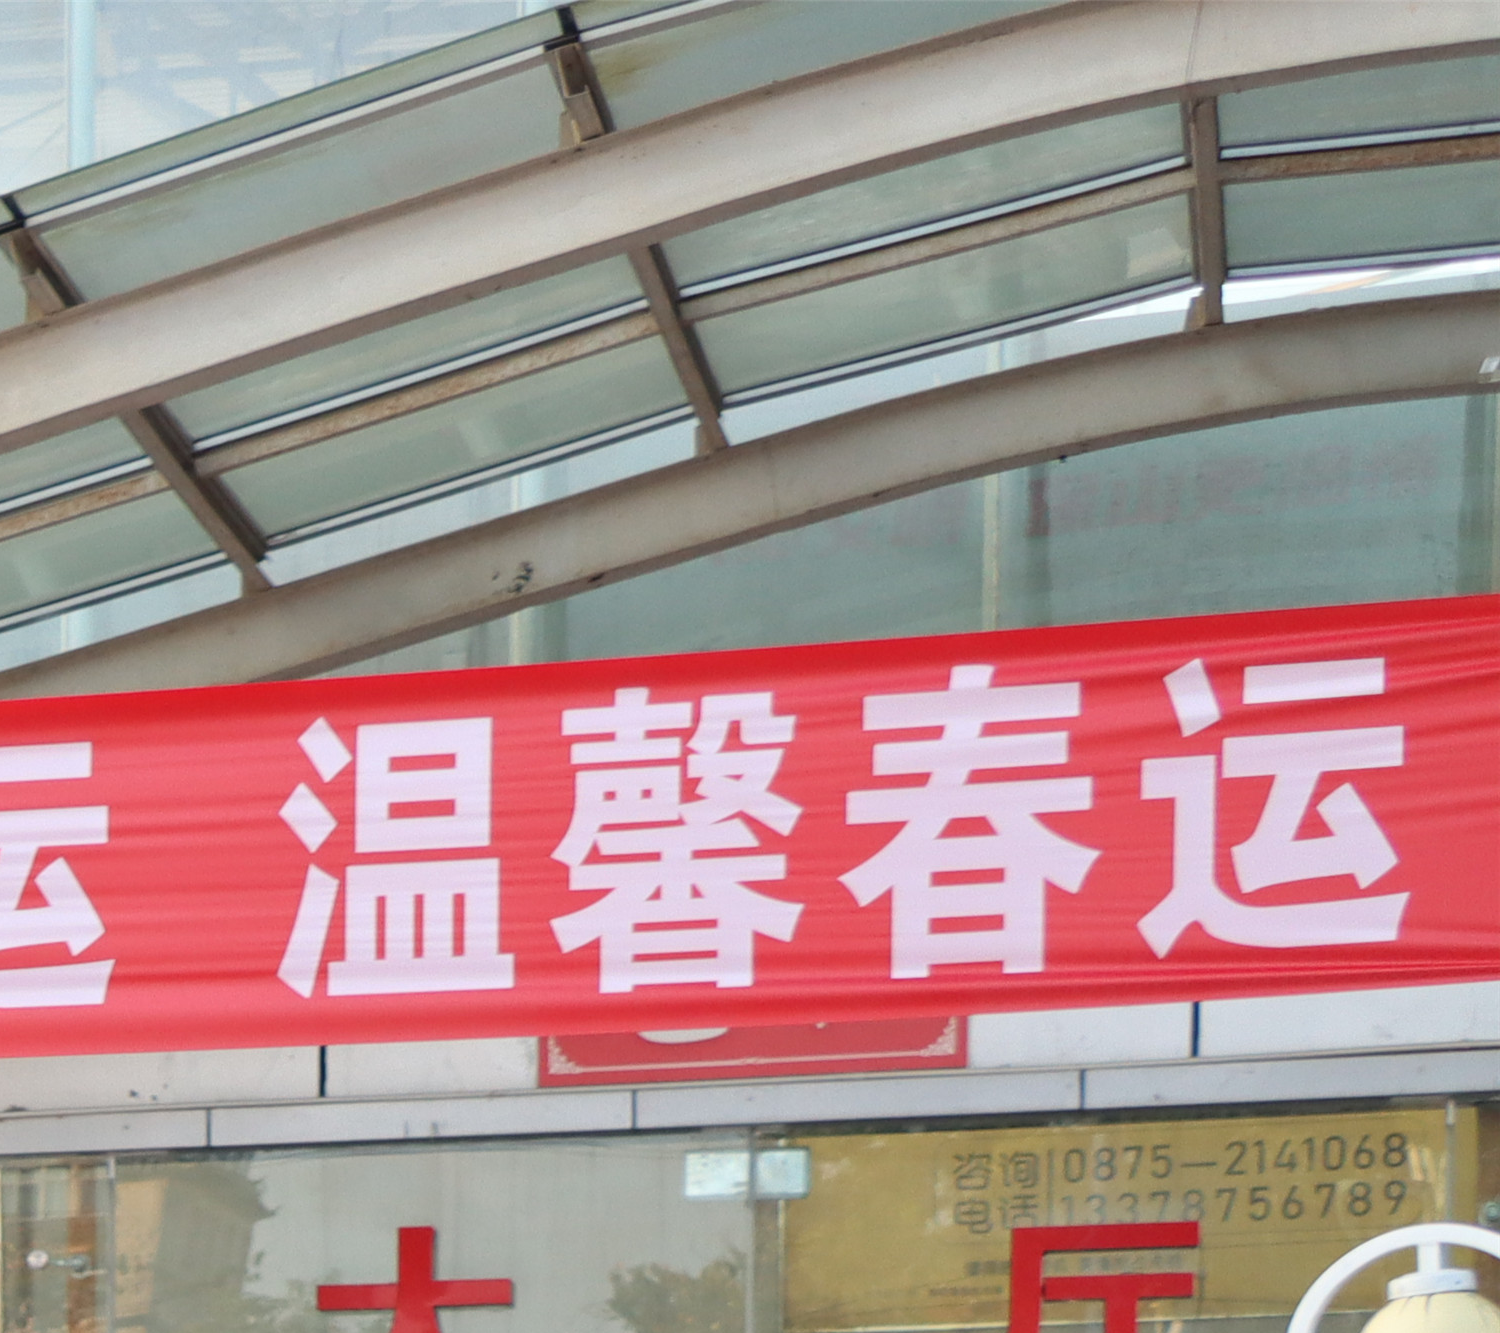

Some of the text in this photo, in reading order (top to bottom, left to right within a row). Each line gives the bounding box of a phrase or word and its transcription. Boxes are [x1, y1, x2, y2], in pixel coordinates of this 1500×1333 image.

[278, 655, 1410, 999] 温馨春运
[952, 1150, 1041, 1192] 咨询
[954, 1194, 1041, 1235] 电话
